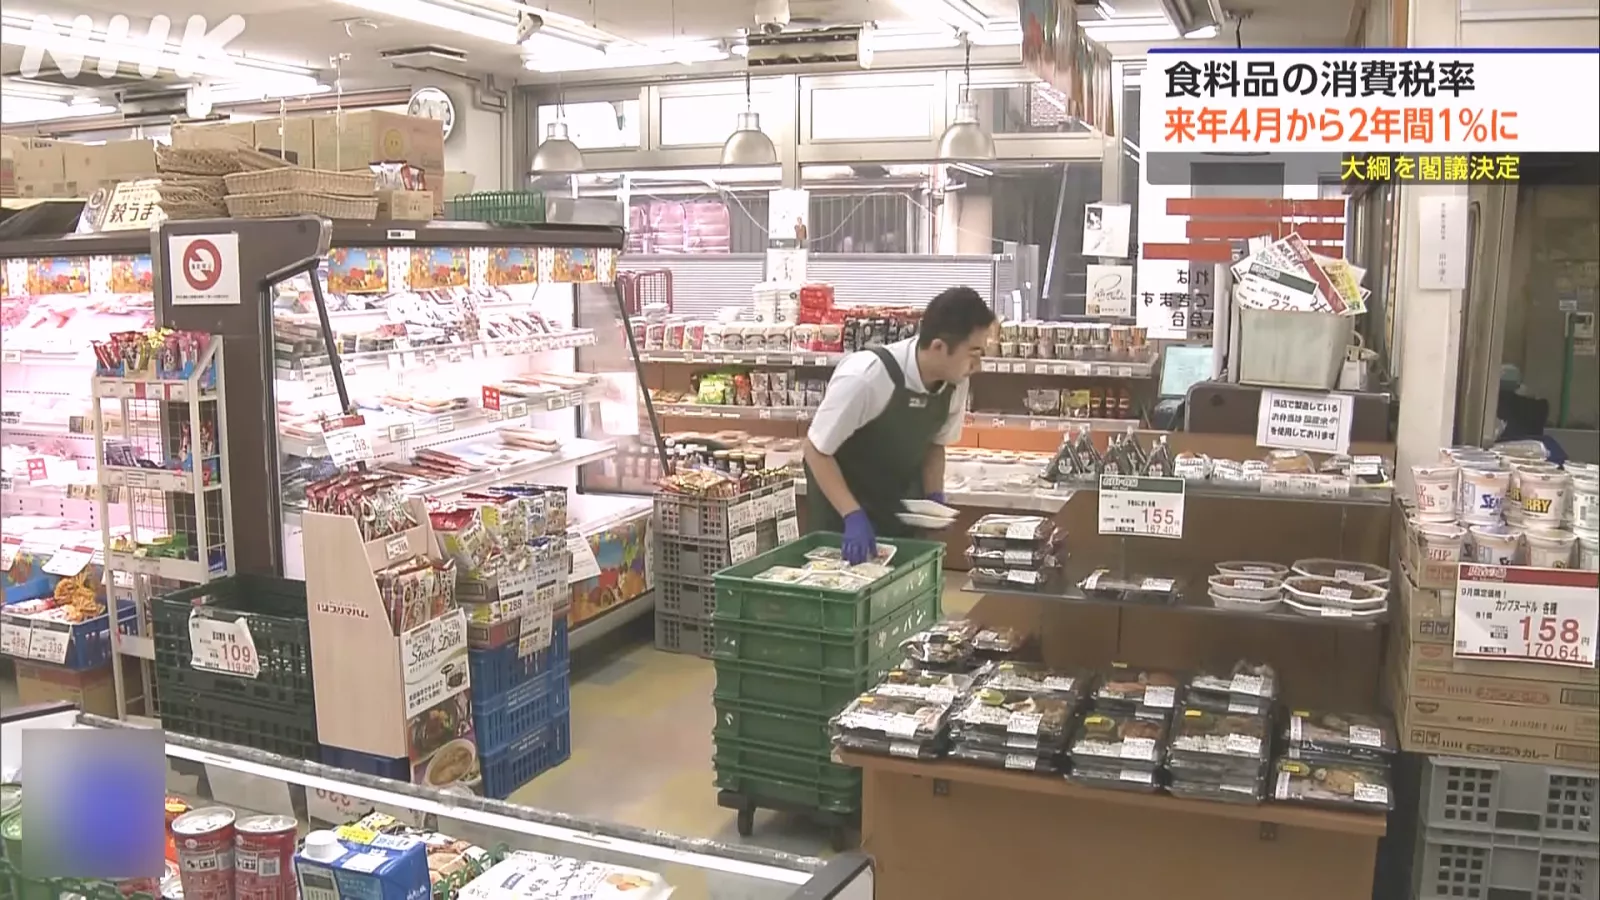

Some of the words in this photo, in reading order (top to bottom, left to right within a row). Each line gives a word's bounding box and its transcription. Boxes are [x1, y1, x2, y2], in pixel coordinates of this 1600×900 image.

[1271, 426, 1335, 440] を使用しております
[1142, 508, 1174, 525] 155
[1495, 600, 1538, 613] カップヌードル
[1543, 602, 1558, 615] 各種
[1519, 616, 1579, 643] 158
[1581, 637, 1590, 646] 円
[221, 644, 251, 663] 109
[1525, 642, 1580, 660] 170.64
